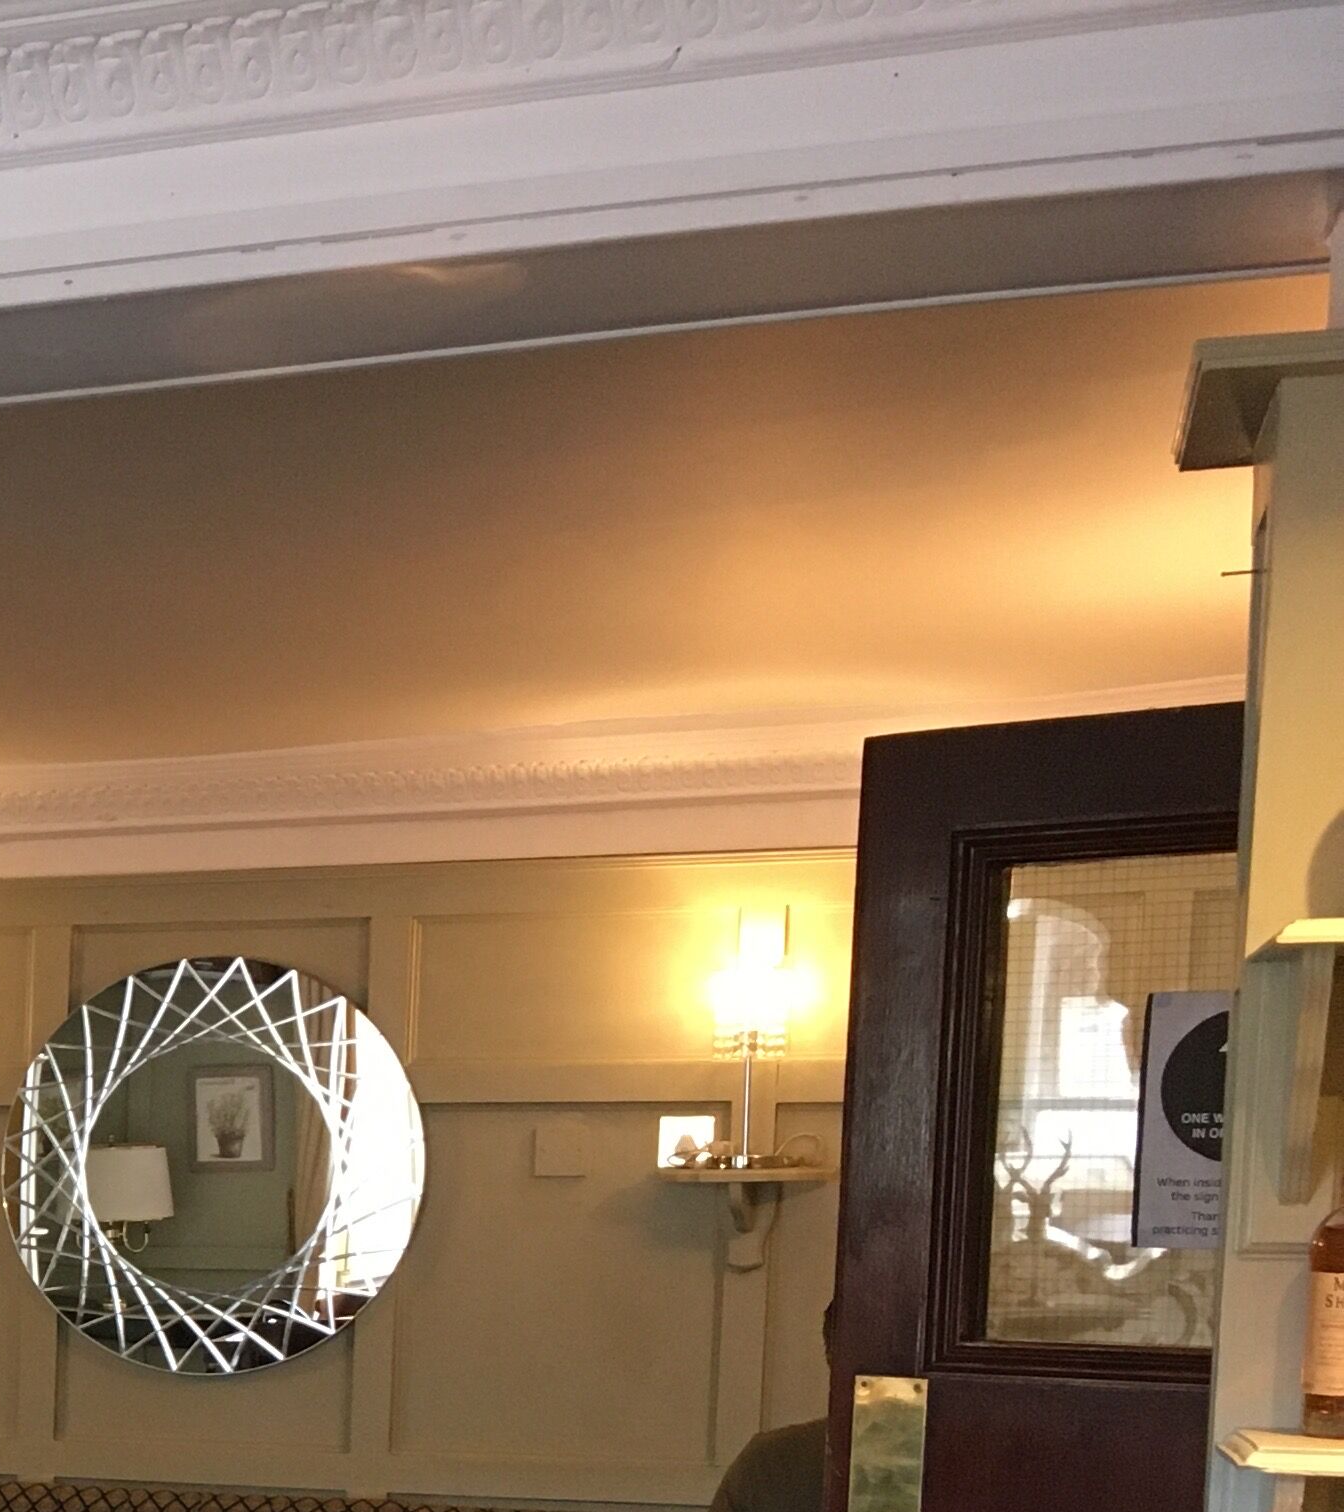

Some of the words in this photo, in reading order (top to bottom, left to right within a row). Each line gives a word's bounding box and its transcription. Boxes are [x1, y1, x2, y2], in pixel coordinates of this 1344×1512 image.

[1181, 1113, 1209, 1123] ONE
[1192, 1127, 1206, 1138] IN
[1157, 1177, 1190, 1187] When
[1171, 1190, 1191, 1201] the
[1194, 1191, 1218, 1204] sign
[1152, 1226, 1208, 1236] practicing
